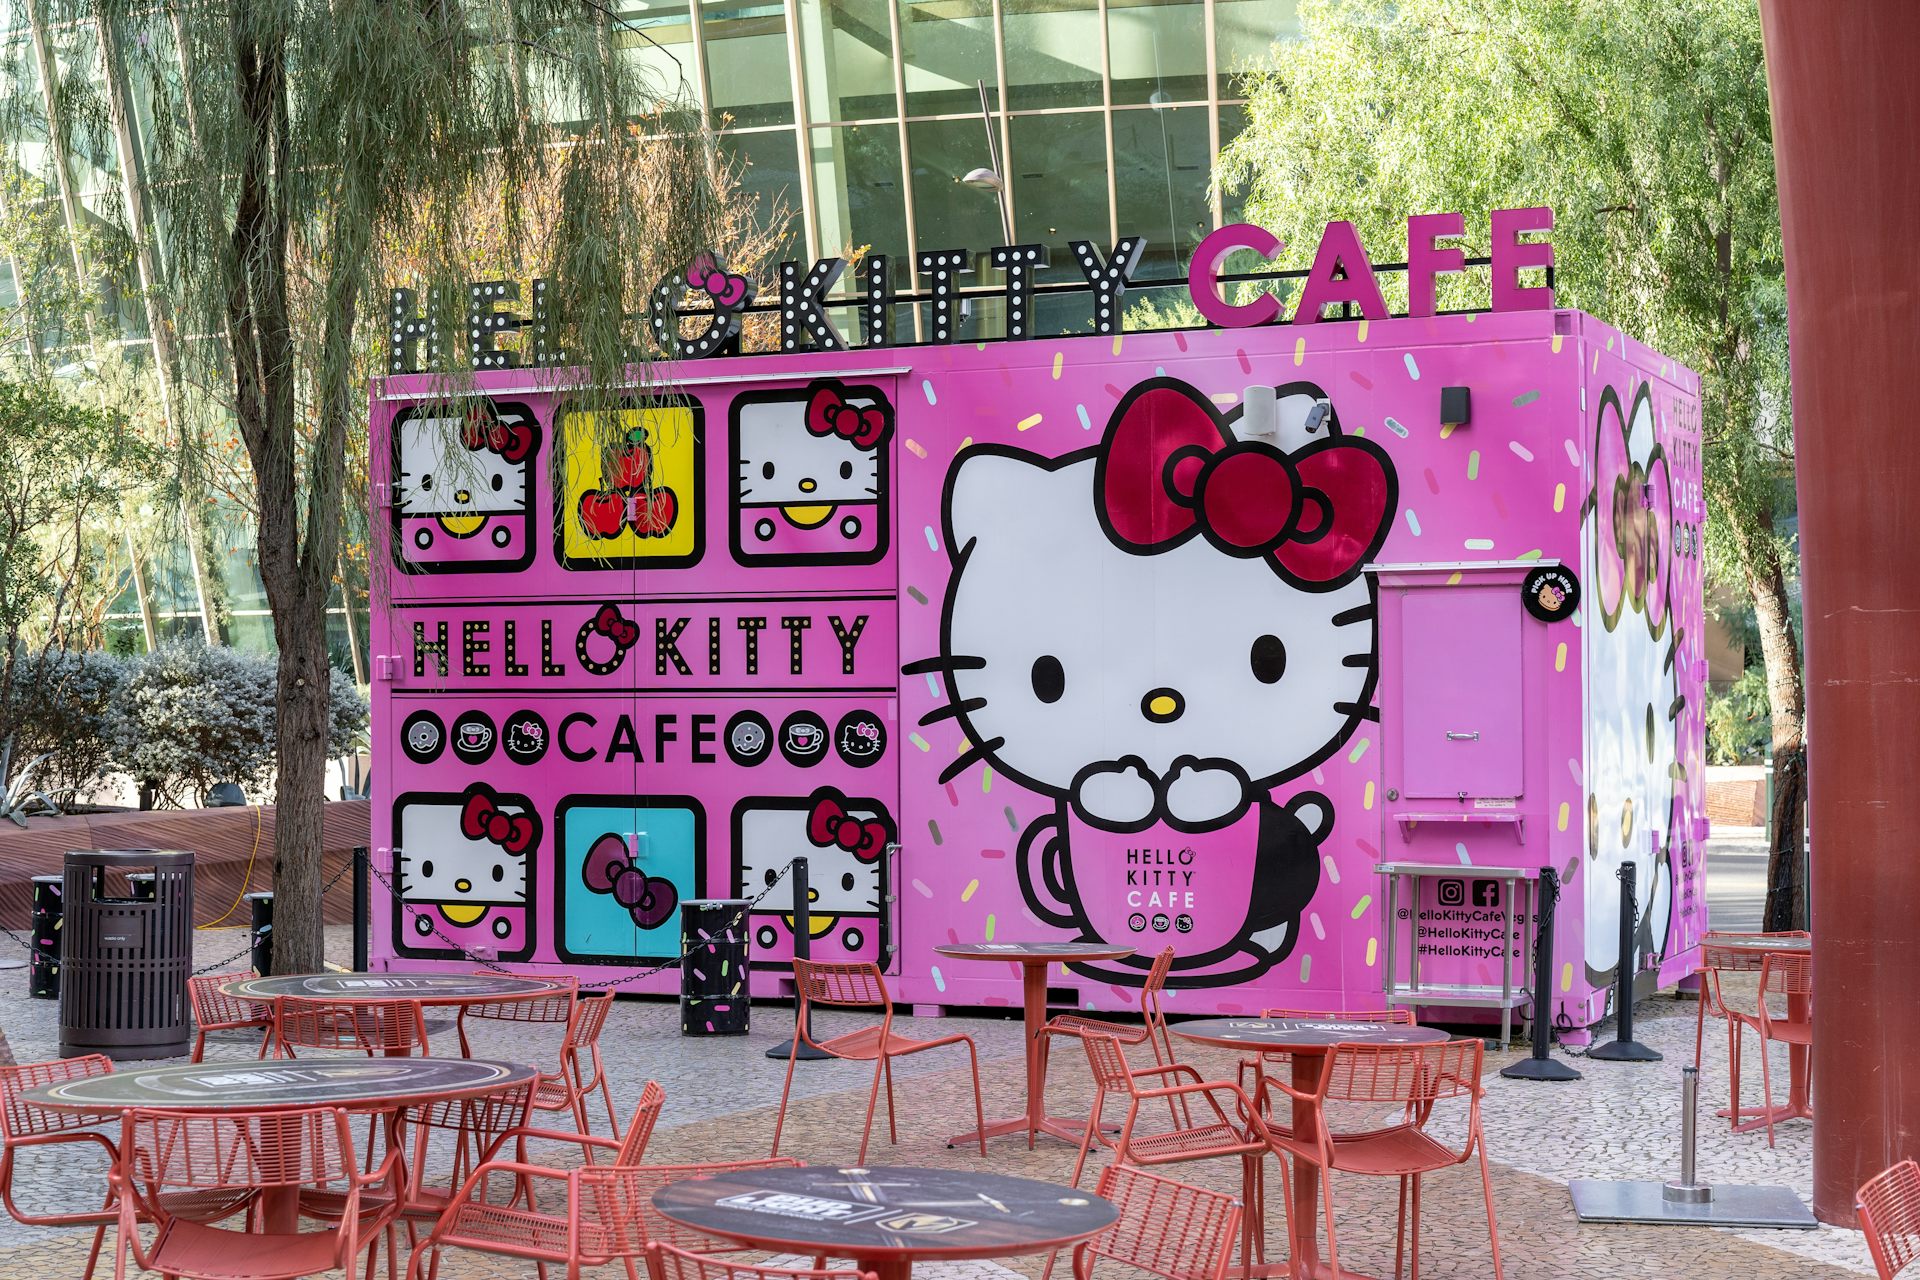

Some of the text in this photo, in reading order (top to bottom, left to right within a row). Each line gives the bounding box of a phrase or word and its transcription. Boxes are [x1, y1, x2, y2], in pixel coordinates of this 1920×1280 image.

[390, 207, 1554, 375] HELO KITTY CAFE
[1673, 395, 1696, 433] HELLO
[1673, 436, 1697, 472] KITTY
[1674, 477, 1699, 514] CAFE
[1530, 575, 1546, 594] PICK
[1557, 575, 1573, 594] HERE
[413, 610, 870, 677] HELLO KITTY
[558, 711, 717, 764] CAFE
[1127, 848, 1194, 865] HELLO
[1127, 870, 1193, 887] KITTY
[1127, 890, 1194, 908] CAFE
[1418, 926, 1520, 941] @HelloKittyCae
[1418, 943, 1520, 959] #HelloKittyCae
